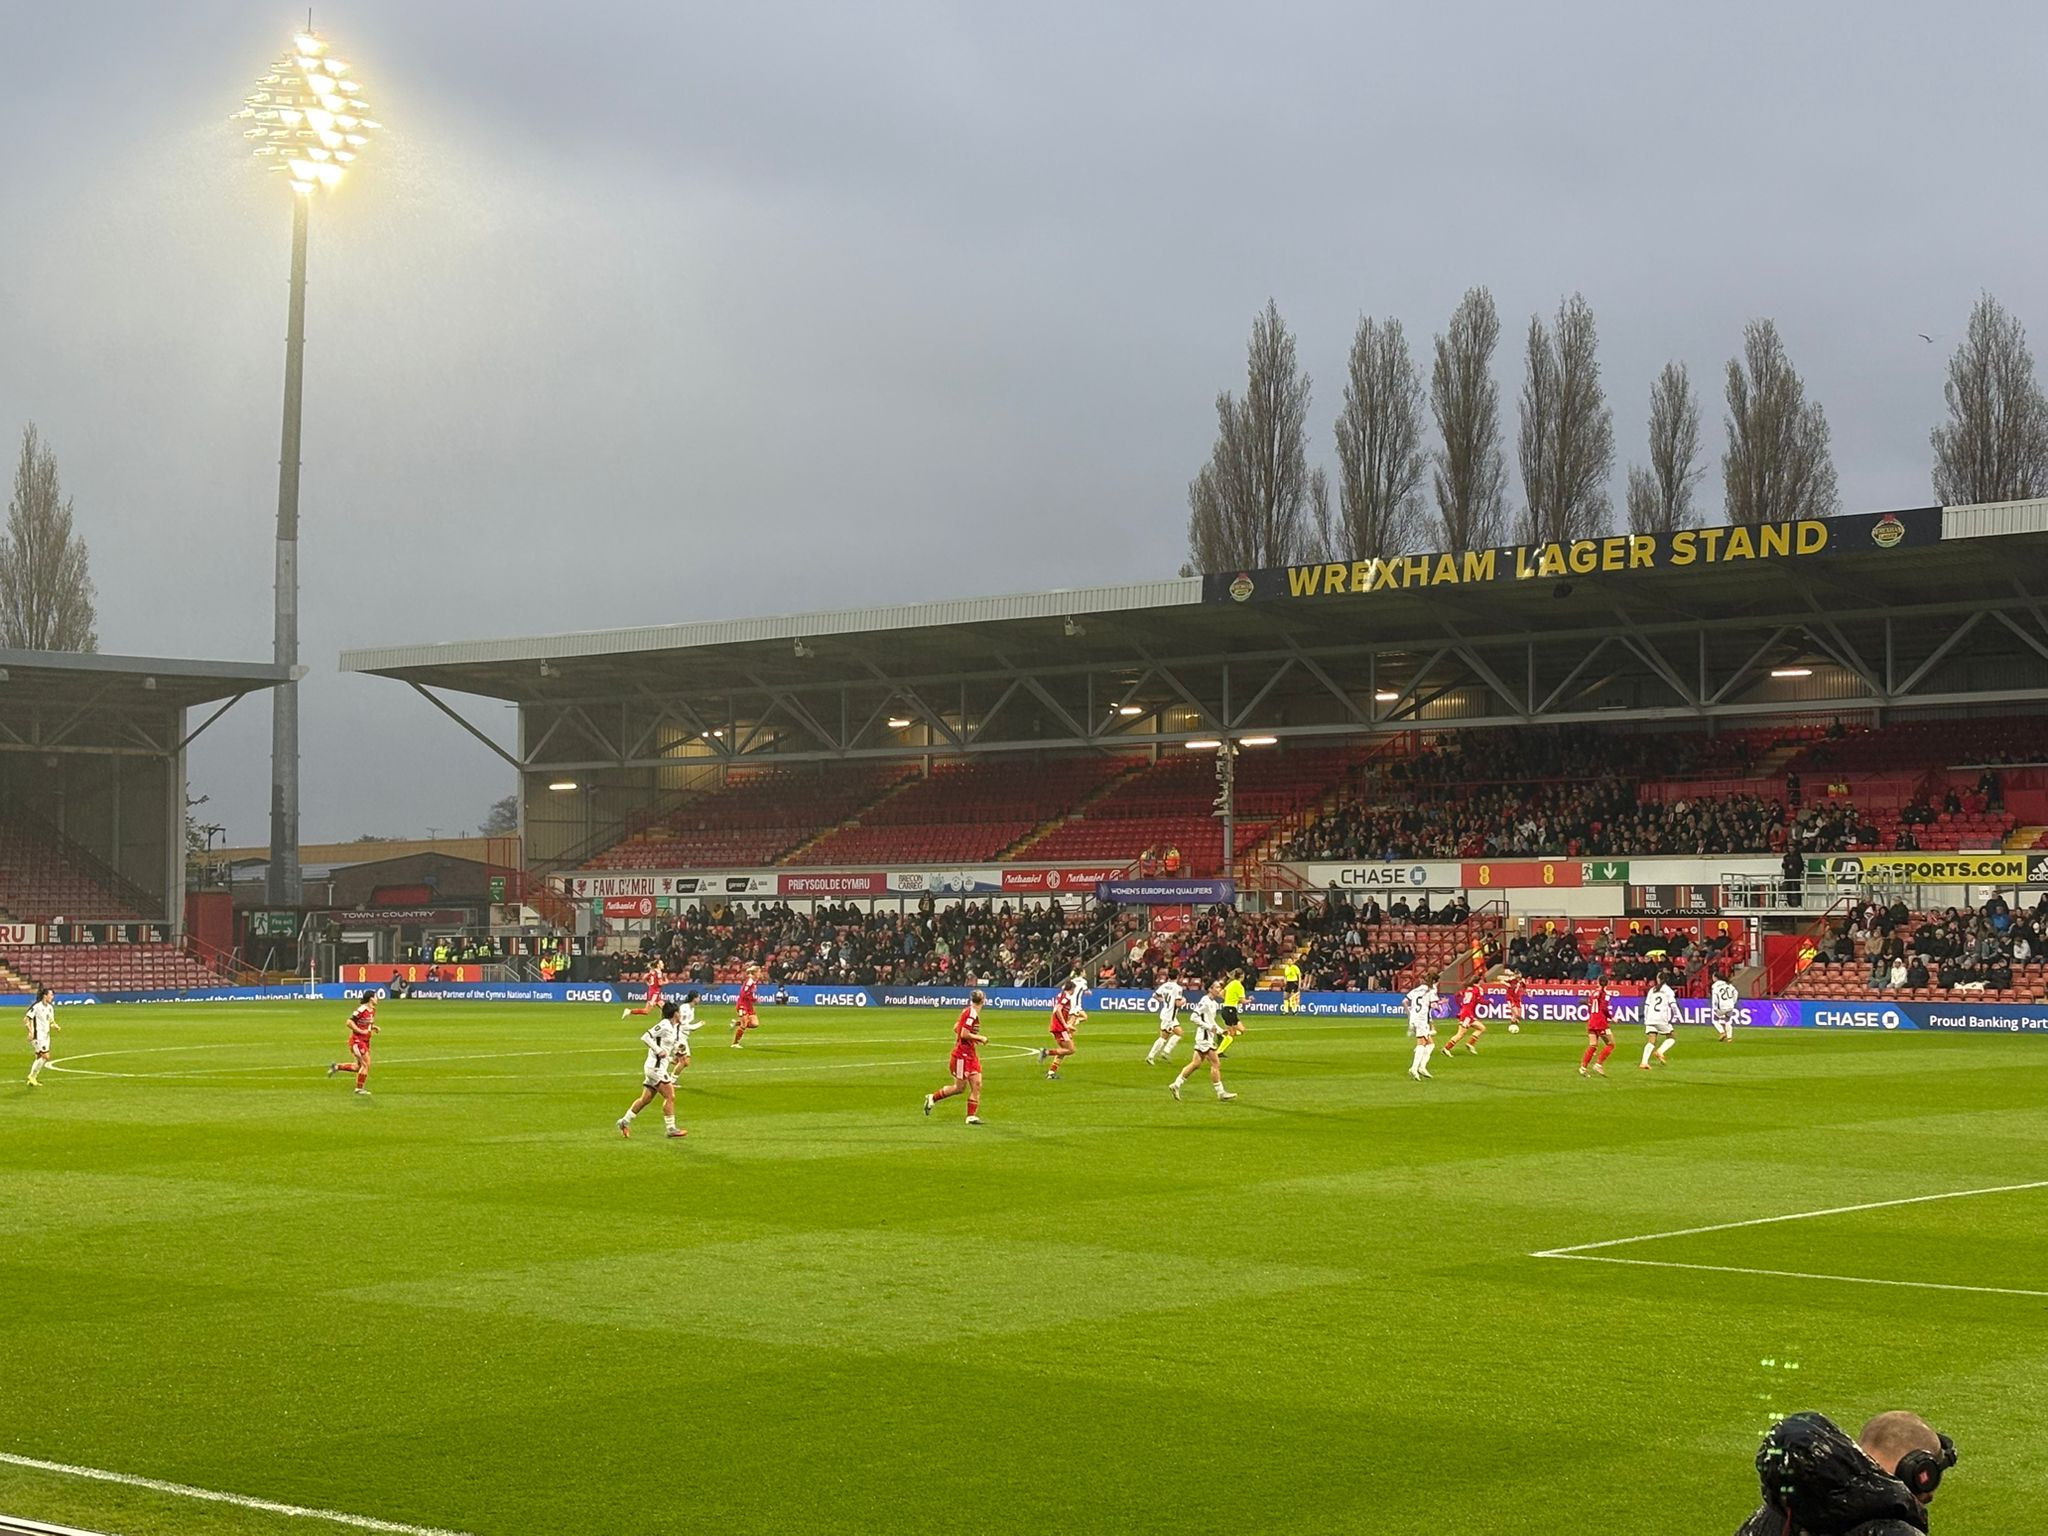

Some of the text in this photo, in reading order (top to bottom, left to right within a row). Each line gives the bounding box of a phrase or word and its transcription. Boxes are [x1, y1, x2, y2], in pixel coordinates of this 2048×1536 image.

[1288, 520, 1828, 597] WREXHAM LAGER STAND
[1341, 868, 1405, 884] CHASE
[594, 878, 655, 895] FAW.CYMRU
[841, 878, 870, 889] CYMRU
[1111, 887, 1212, 895] WOMEN'S EUROPEAN QUALIFIERS
[443, 990, 465, 999] Partner
[485, 990, 506, 1000] Cymru
[566, 990, 601, 1001] CHASE
[627, 992, 647, 1000] Proud
[815, 993, 853, 1005] CHASE
[885, 996, 907, 1005] Proud
[909, 996, 936, 1008] Banking
[941, 996, 969, 1006] Partner
[994, 997, 1020, 1008] Cymru
[1021, 998, 1054, 1007] National
[1100, 997, 1145, 1010] CHASE
[1415, 996, 1423, 1013] 5
[1654, 996, 1662, 1012] 2
[1308, 1003, 1338, 1015] Cymru
[1340, 1003, 1379, 1014] National
[1382, 1004, 1408, 1014] Team
[1475, 1003, 1539, 1020] OME'S
[1543, 1004, 1640, 1024] EUROAN
[1815, 1011, 1879, 1027] CHASE
[1930, 1015, 1966, 1027] Proud
[1969, 1016, 2019, 1031] Banking
